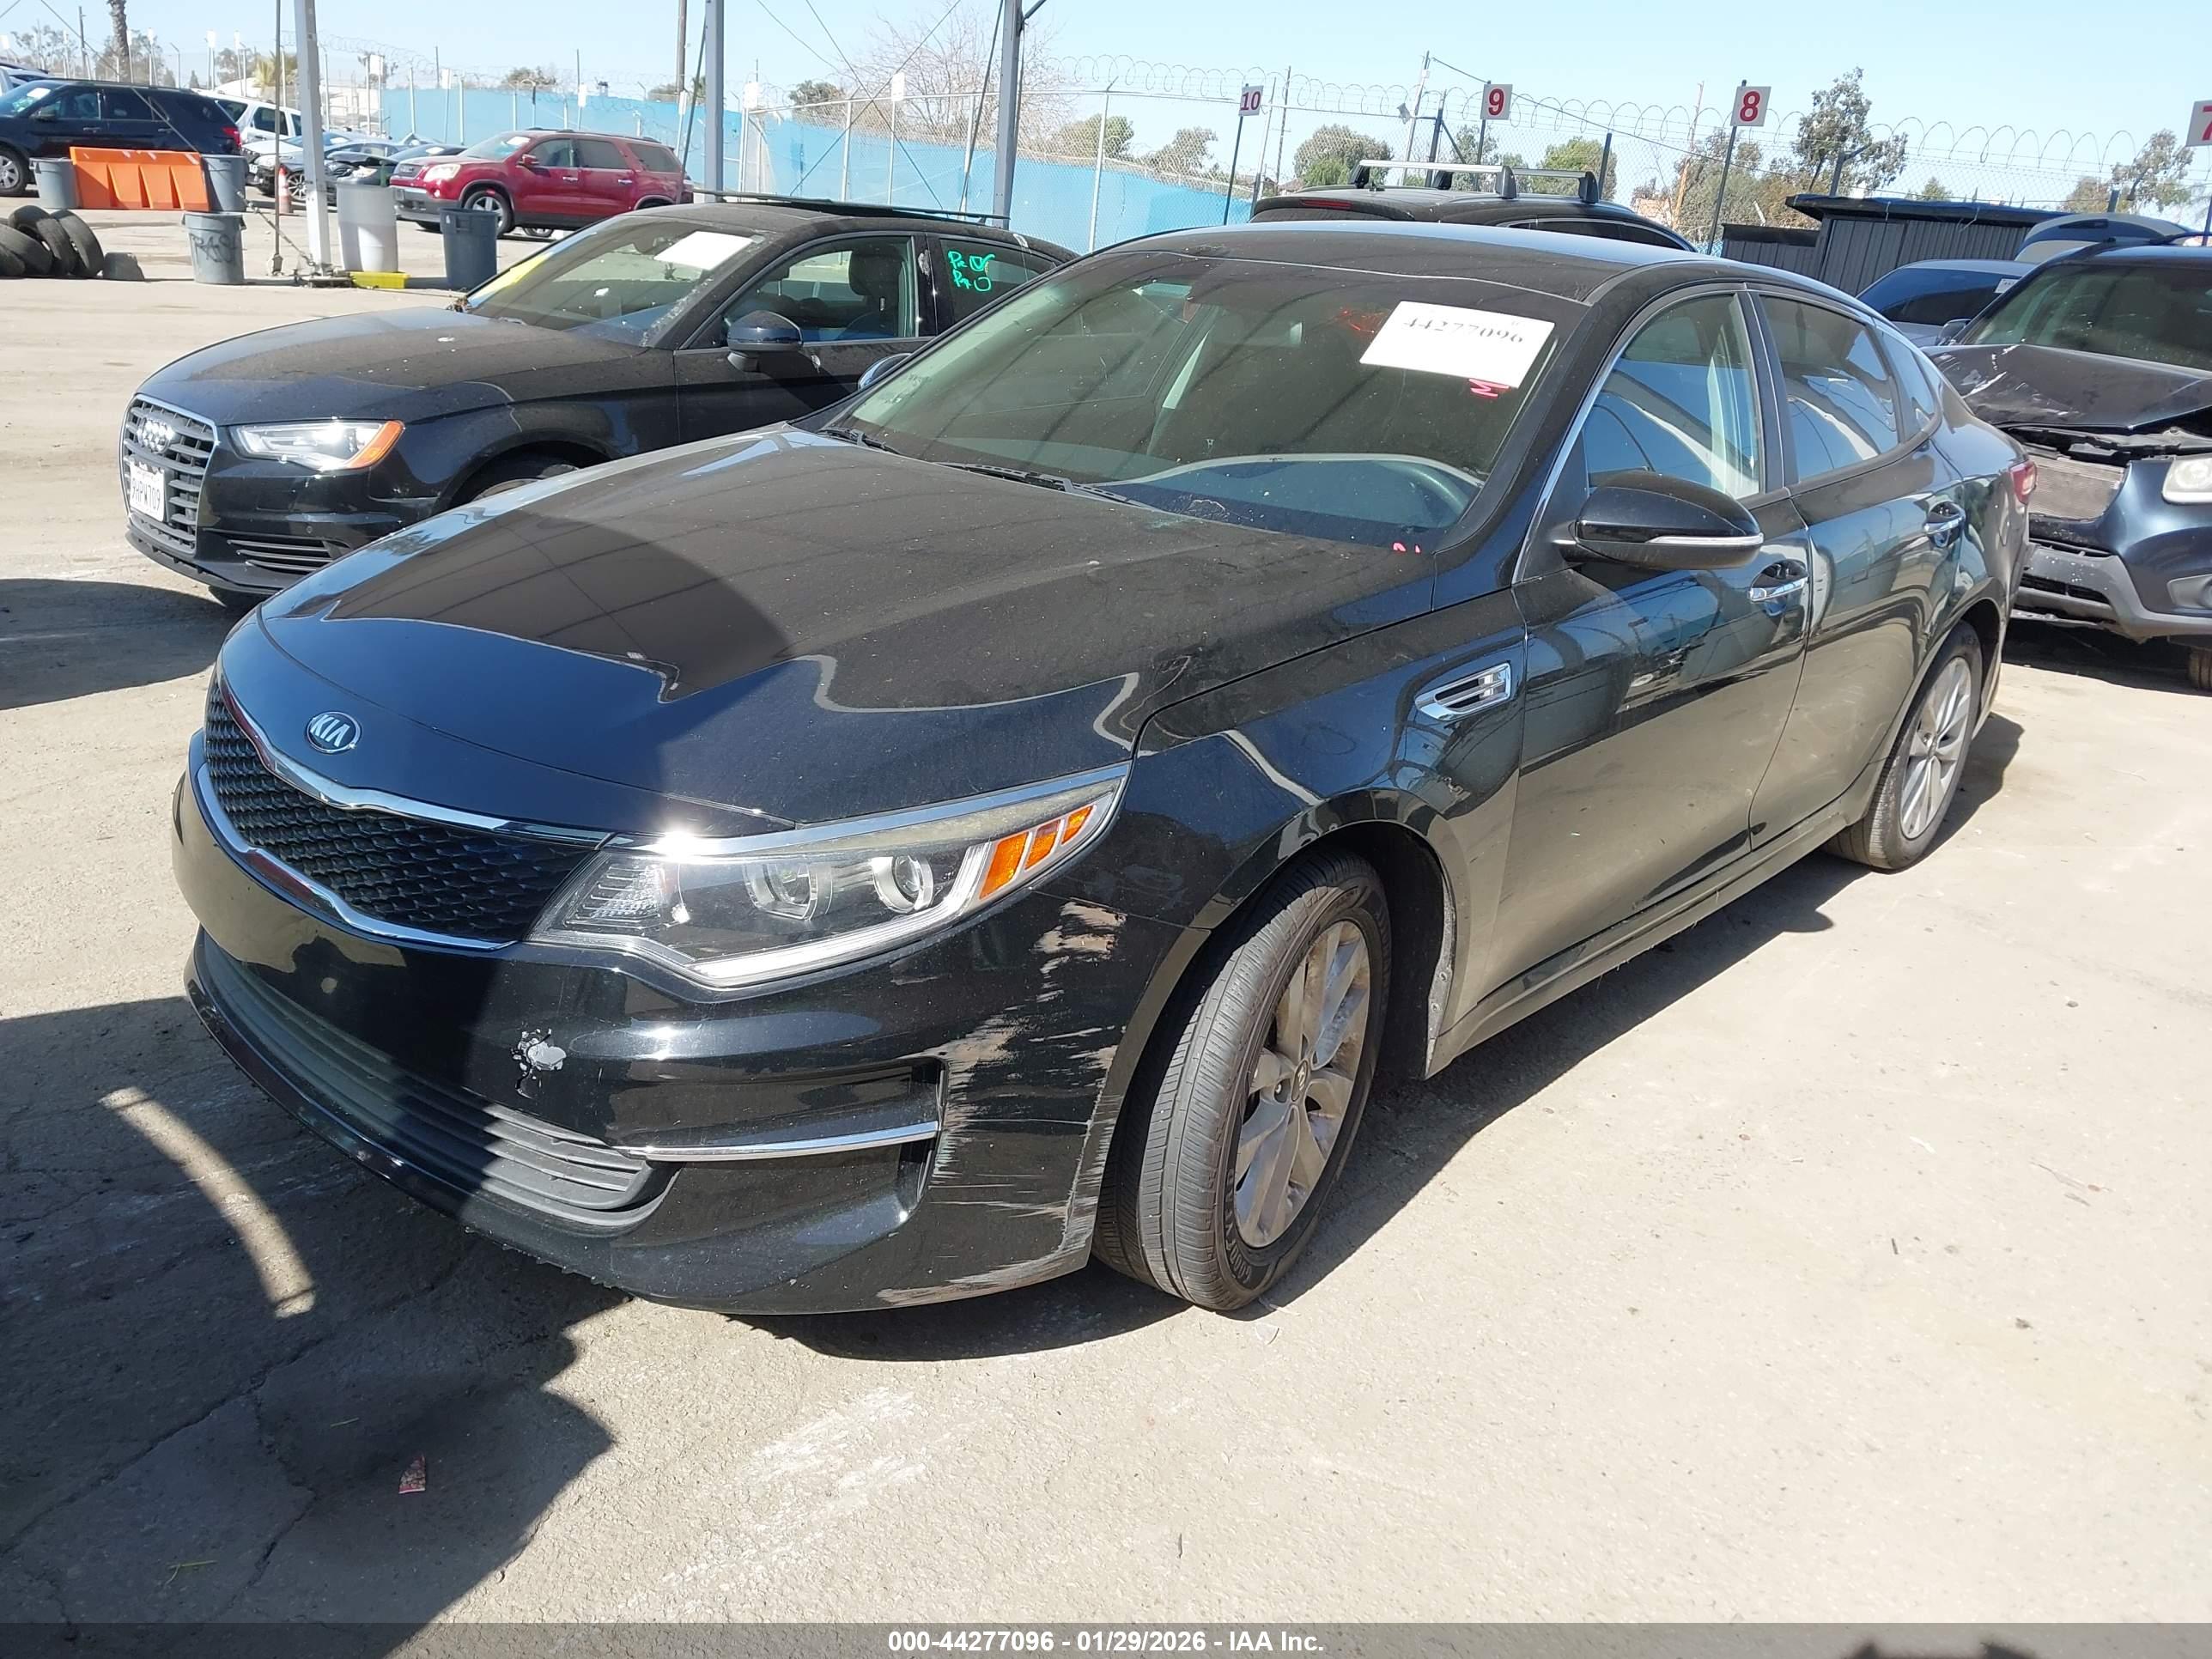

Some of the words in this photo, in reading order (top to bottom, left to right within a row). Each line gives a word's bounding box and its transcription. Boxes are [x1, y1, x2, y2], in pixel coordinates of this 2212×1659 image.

[1240, 91, 1261, 111] 10
[1488, 88, 1504, 116] 9
[1740, 91, 1760, 122] 8
[1402, 316, 1524, 343] 44277096
[310, 714, 351, 748] KIA
